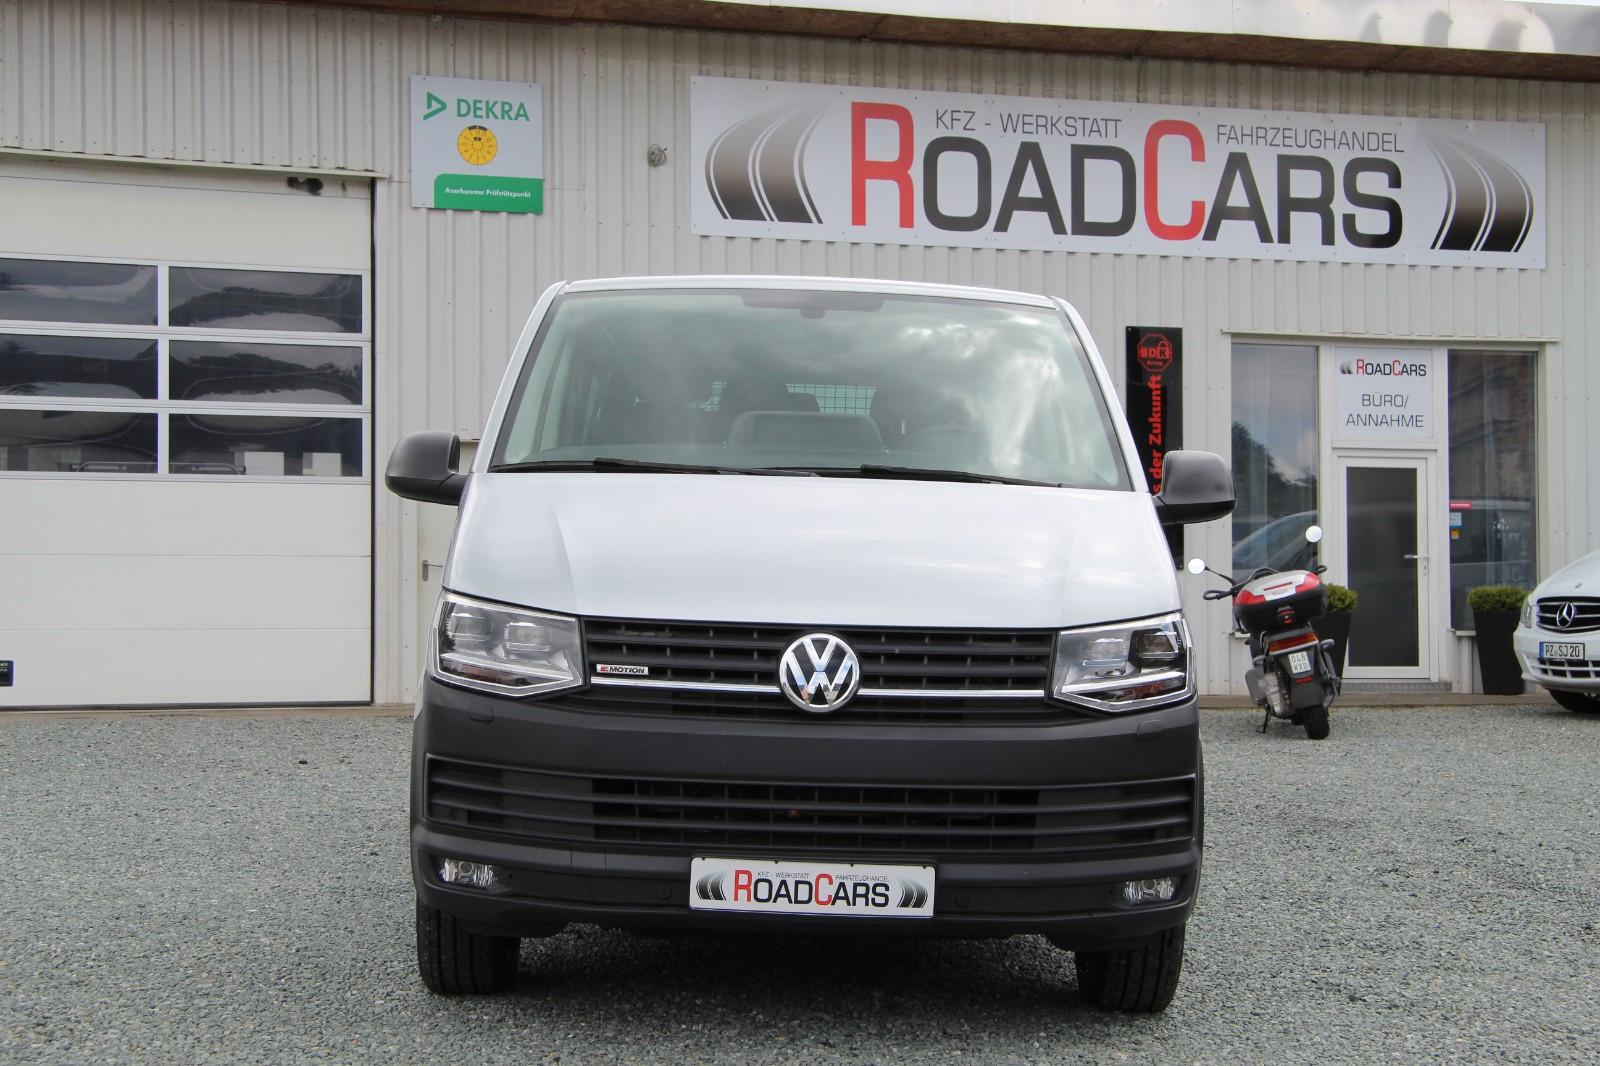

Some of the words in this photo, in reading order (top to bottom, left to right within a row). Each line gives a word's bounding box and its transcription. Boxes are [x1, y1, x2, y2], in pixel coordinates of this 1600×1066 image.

[456, 98, 530, 122] DEKRA
[936, 109, 976, 132] KFZ
[1000, 113, 1122, 139] WERKSTATT
[1216, 124, 1405, 153] FAHRZEUGHANDEL
[1148, 375, 1162, 446] Zukunft
[1345, 413, 1424, 427] ANNAHME
[1149, 450, 1162, 479] der
